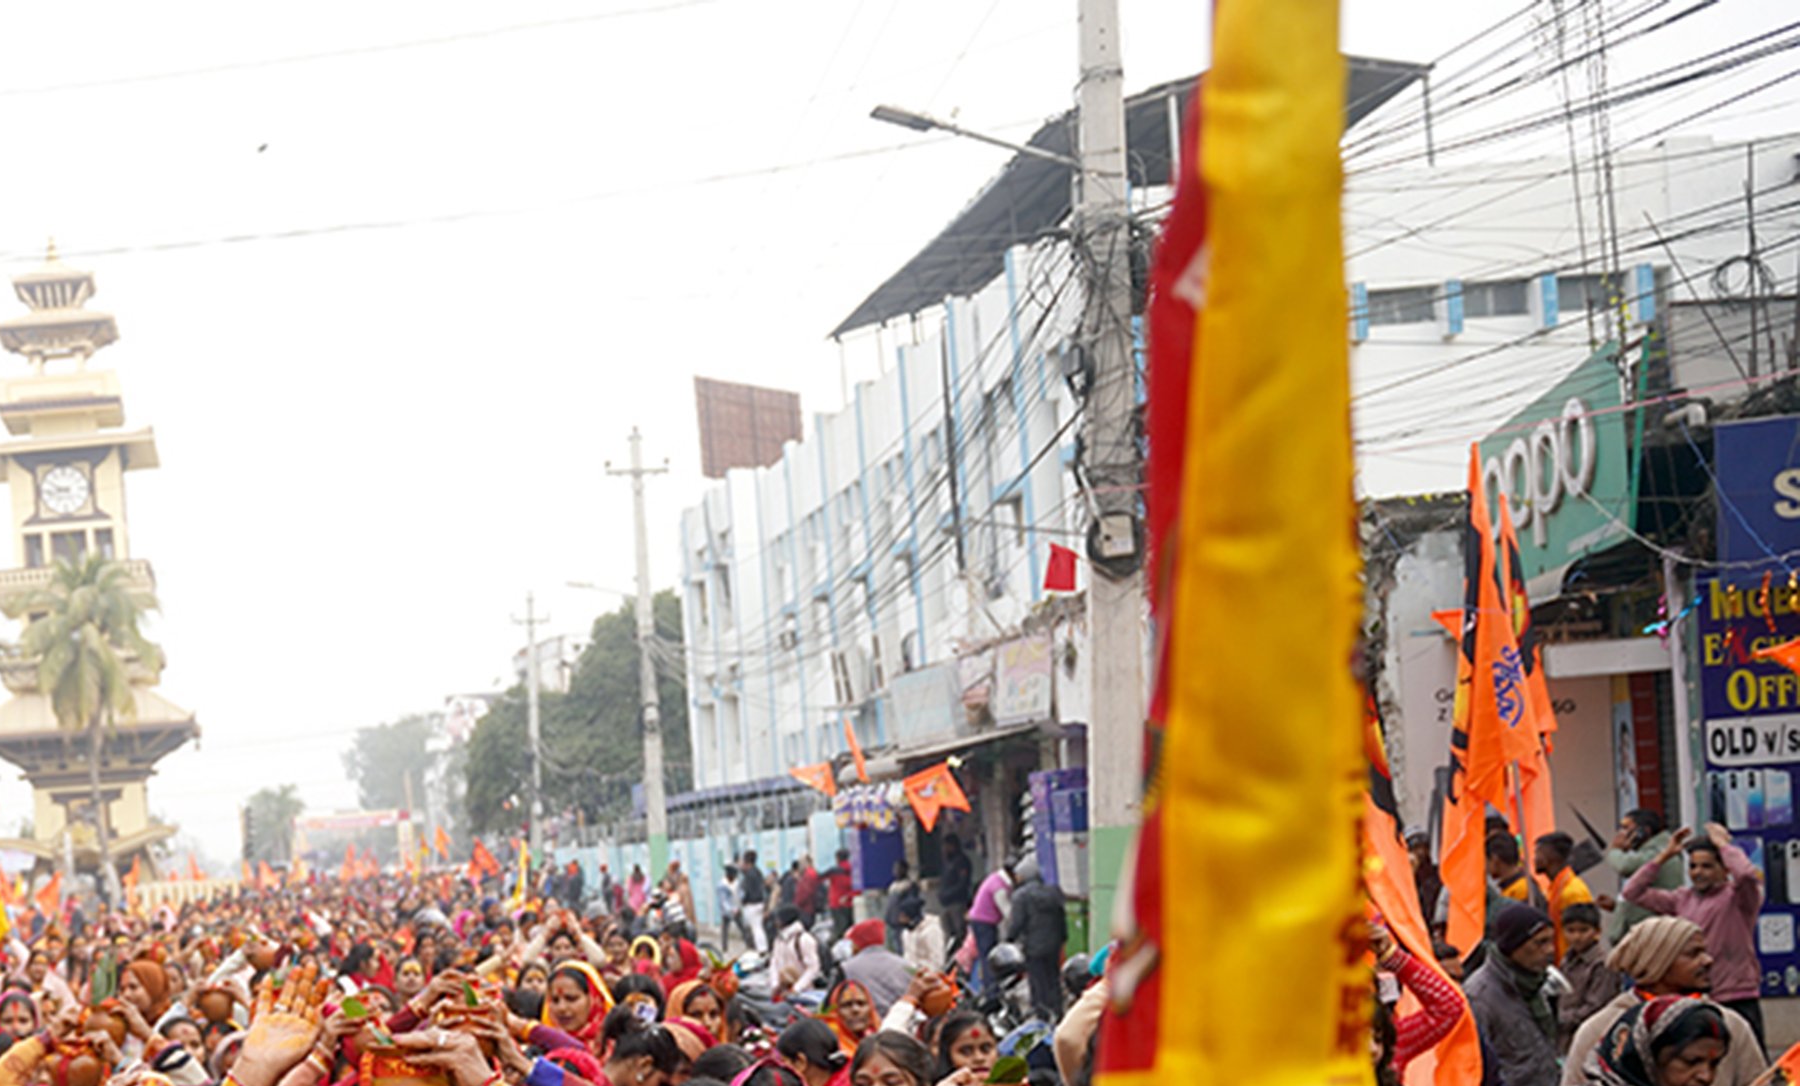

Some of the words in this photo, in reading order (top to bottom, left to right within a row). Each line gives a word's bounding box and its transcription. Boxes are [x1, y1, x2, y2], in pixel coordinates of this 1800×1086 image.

[1482, 398, 1594, 547] oppo
[1726, 669, 1800, 711] OFF
[1711, 726, 1757, 758] OLD
